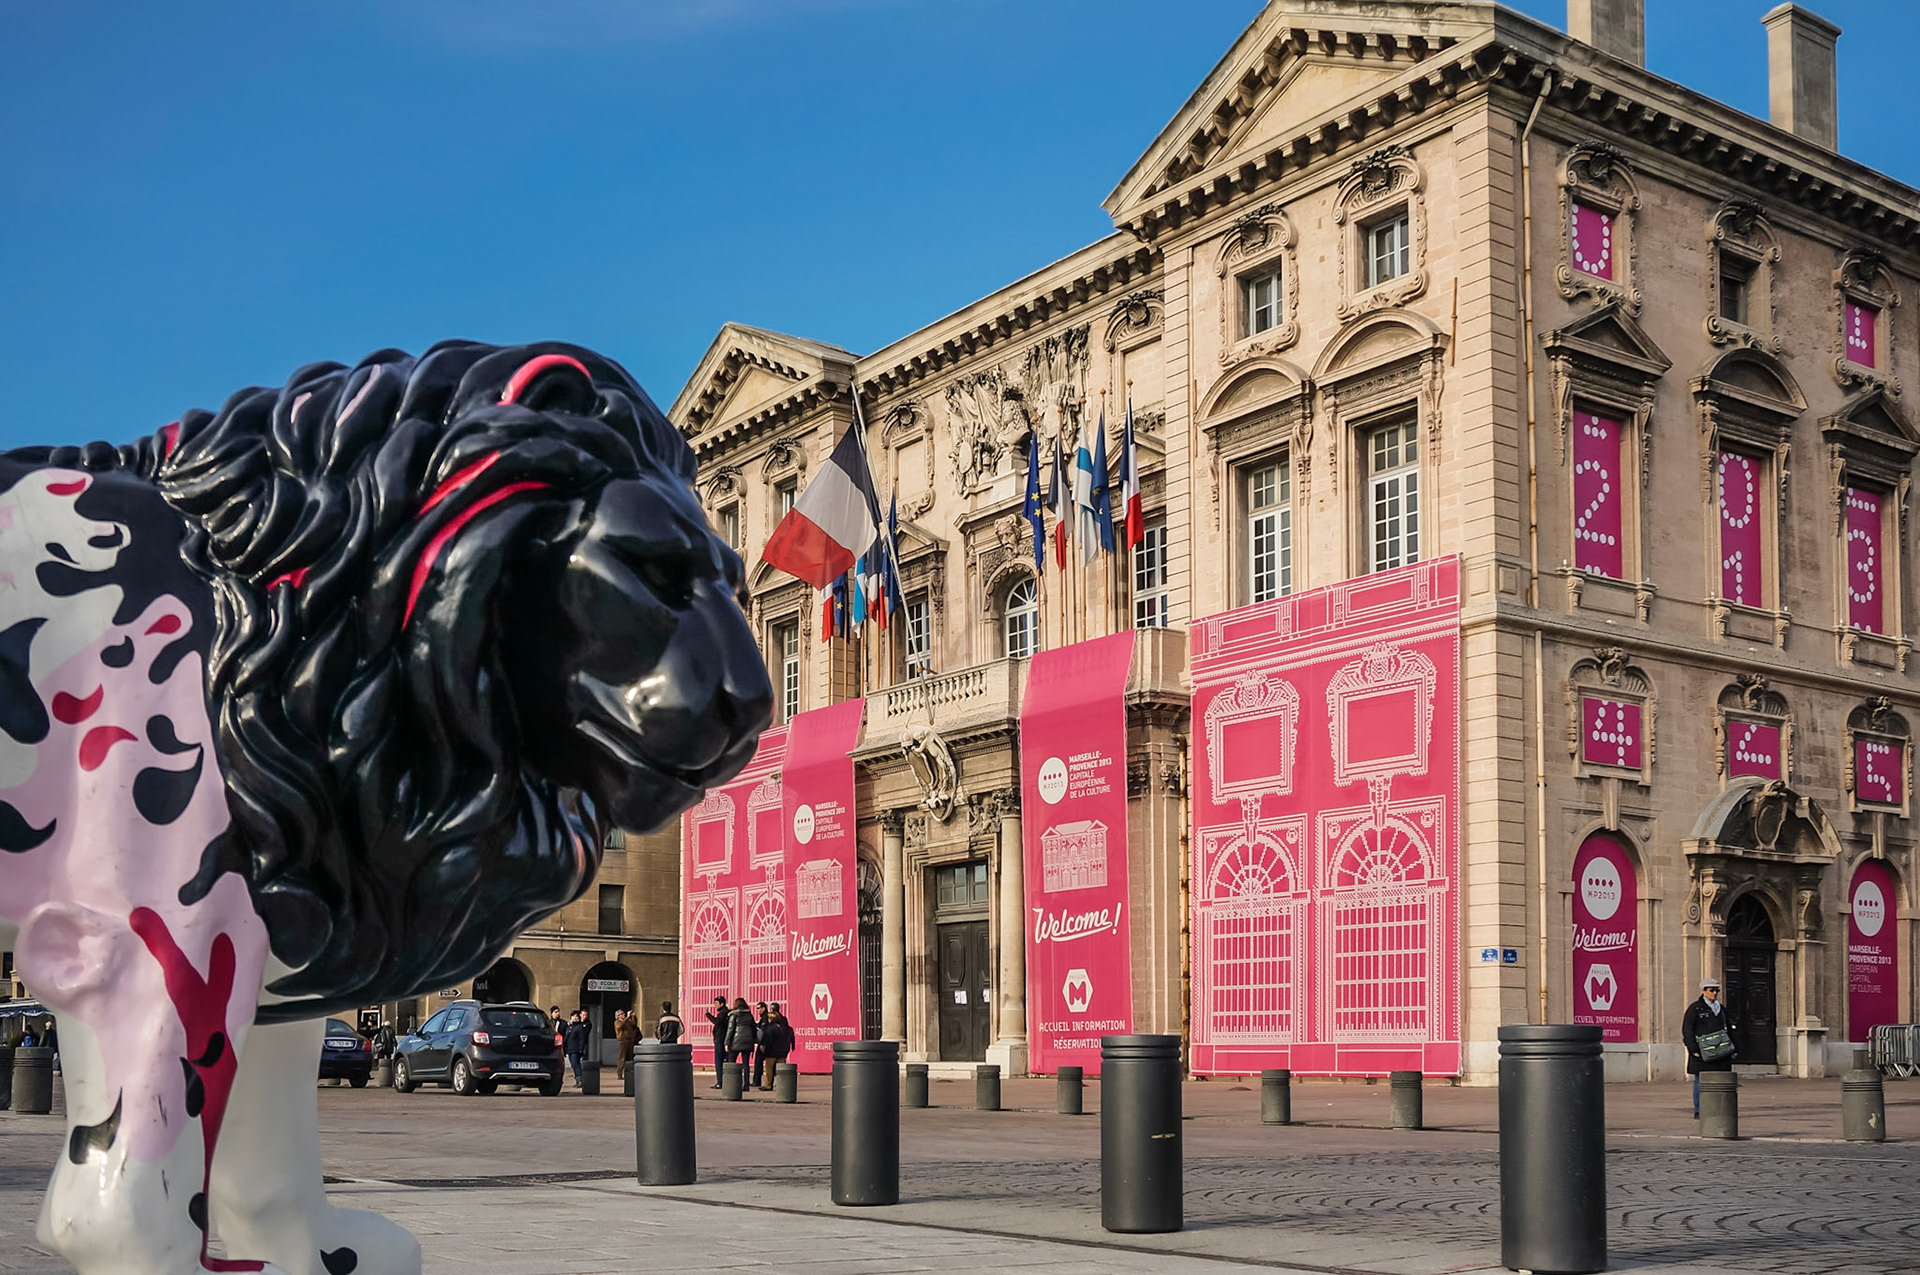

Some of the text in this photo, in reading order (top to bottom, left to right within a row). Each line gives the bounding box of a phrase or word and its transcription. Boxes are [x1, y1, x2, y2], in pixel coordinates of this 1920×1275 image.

[1069, 757, 1112, 772] PROVENCE 2013
[1069, 770, 1095, 781] CAPITALE
[1070, 776, 1106, 790] EUROPÉENNE
[1070, 784, 1111, 799] DE LA CULTURE
[1588, 890, 1616, 900] MP2013
[1032, 902, 1122, 944] Welcome!
[1572, 923, 1636, 952] Welcome!
[790, 928, 853, 961] Welcome!
[1849, 954, 1892, 965] PROVENCE 2013
[1574, 1015, 1635, 1024] CCUEIL INFORMATION
[795, 1026, 856, 1036] ACCUEIL INFORMATION
[1039, 1020, 1125, 1032] ACCUEIL INFORMATION
[805, 1039, 833, 1050] RÉSERVAT
